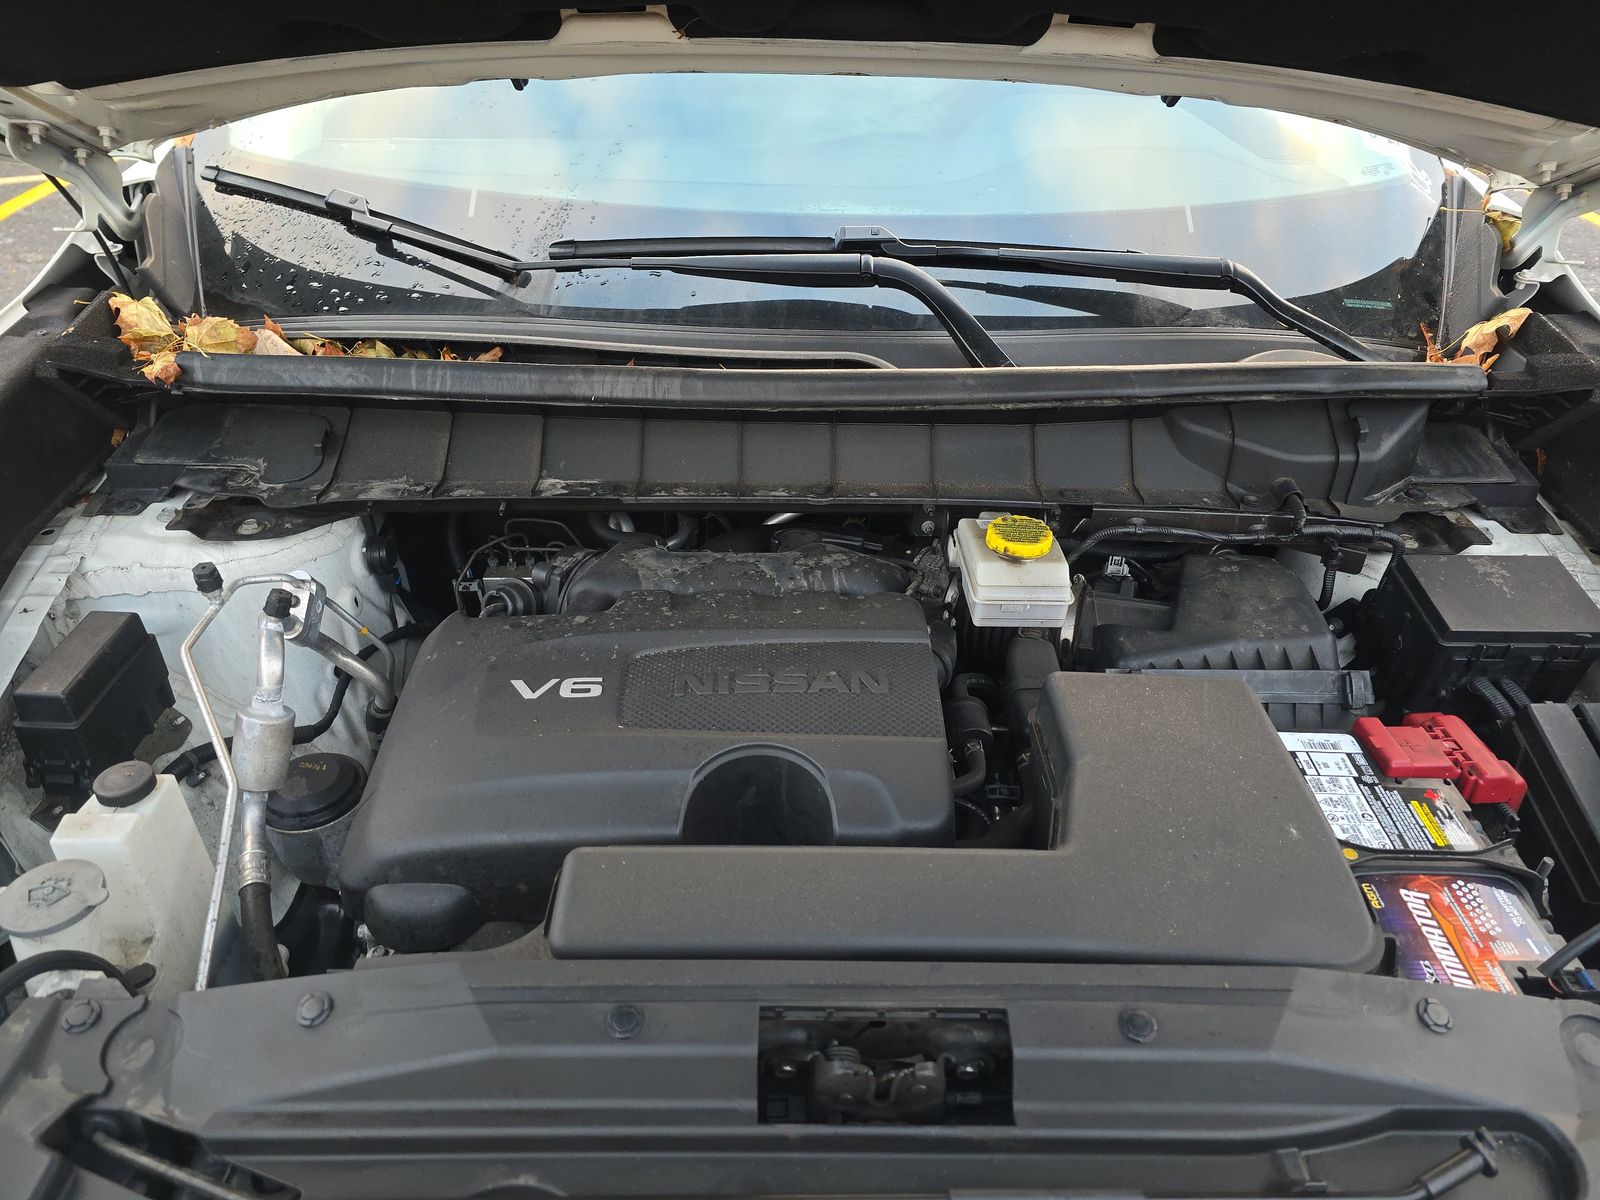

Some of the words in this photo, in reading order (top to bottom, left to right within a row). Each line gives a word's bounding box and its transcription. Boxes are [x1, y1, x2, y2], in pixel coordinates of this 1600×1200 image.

[510, 677, 603, 699] V6
[674, 670, 889, 696] NISSAN
[1361, 883, 1382, 908] AGM
